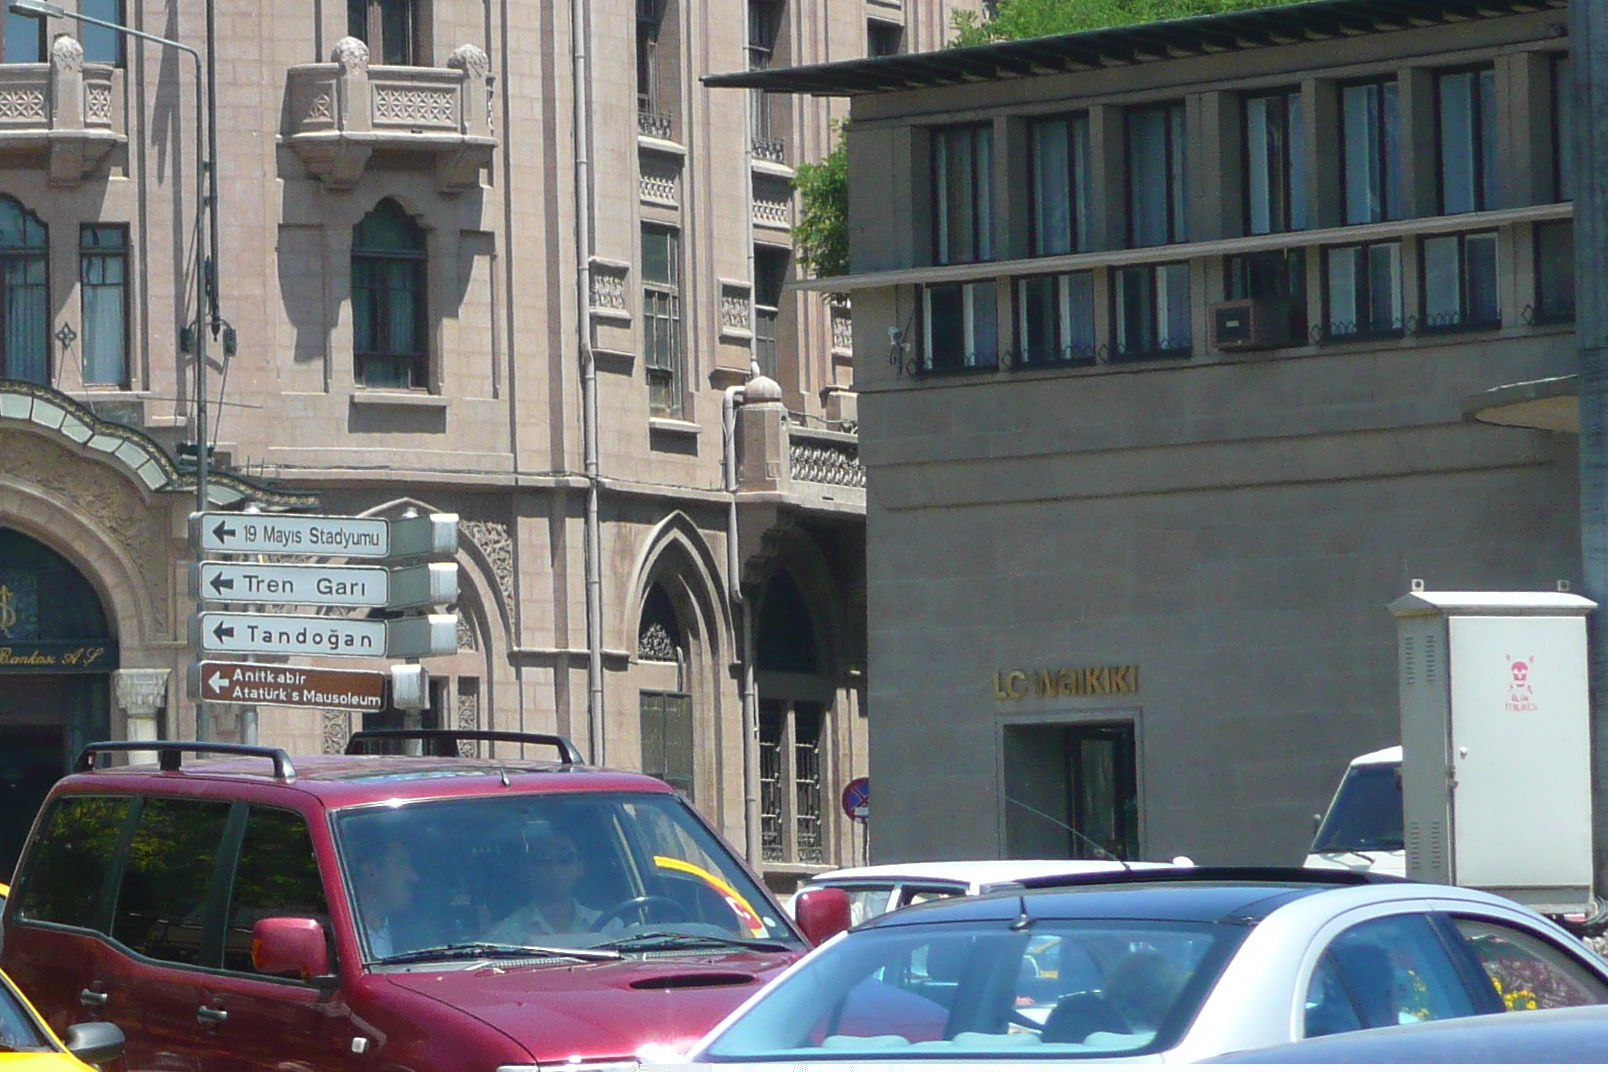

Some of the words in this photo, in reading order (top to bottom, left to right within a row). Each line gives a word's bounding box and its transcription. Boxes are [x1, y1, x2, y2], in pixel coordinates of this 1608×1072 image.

[244, 525, 257, 542] 19
[309, 526, 380, 549] Stadyumu
[242, 575, 294, 594] Tren
[247, 625, 373, 650] Tandoğan
[993, 670, 1027, 699] LC
[303, 689, 382, 707] Mausoleum
